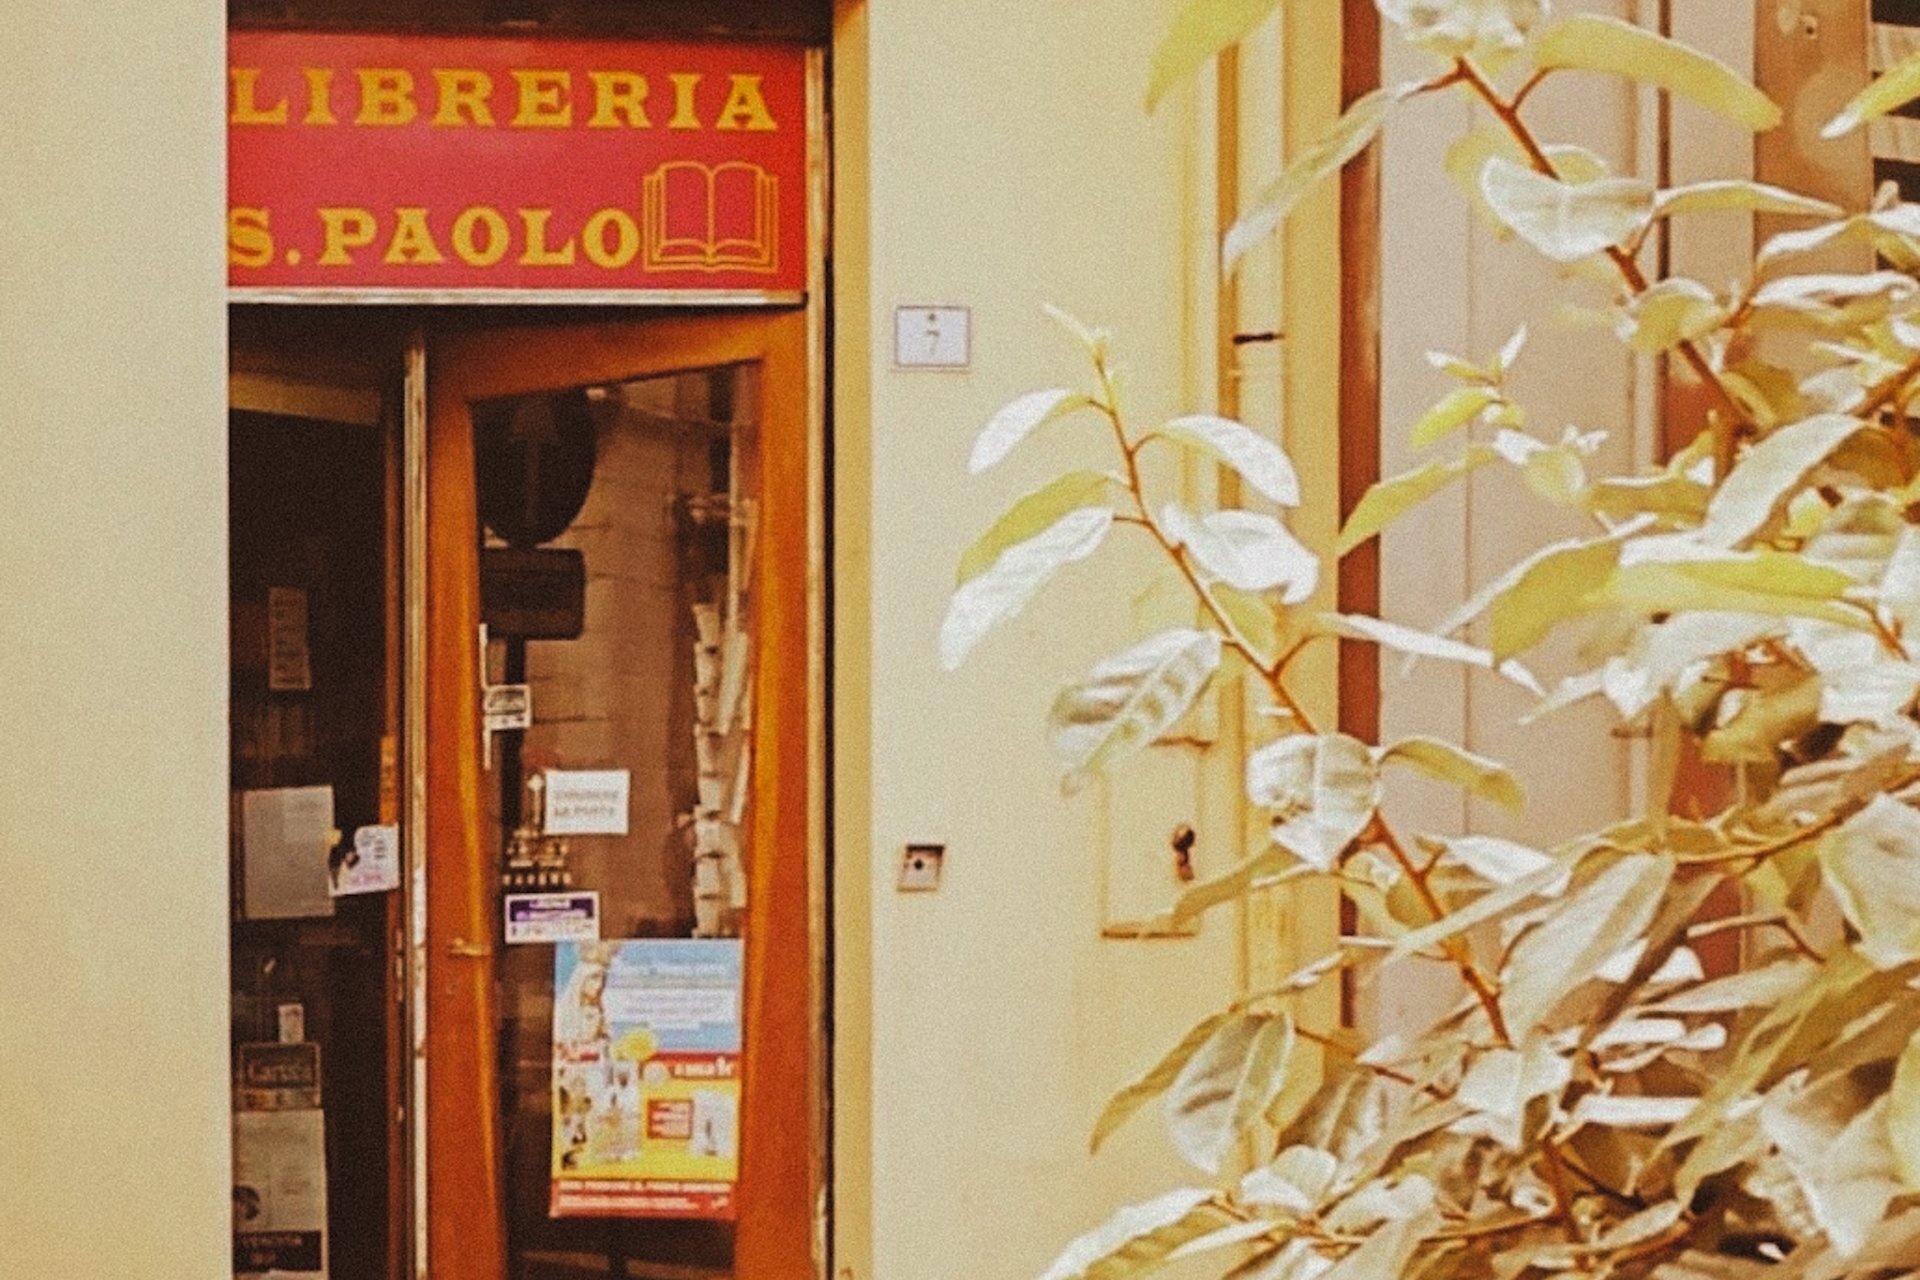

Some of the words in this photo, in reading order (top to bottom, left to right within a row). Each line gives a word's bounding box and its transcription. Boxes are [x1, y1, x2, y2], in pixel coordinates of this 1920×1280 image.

[230, 69, 778, 130] LIBRERIA
[228, 207, 641, 268] S.PAOLO
[926, 330, 941, 356] 7
